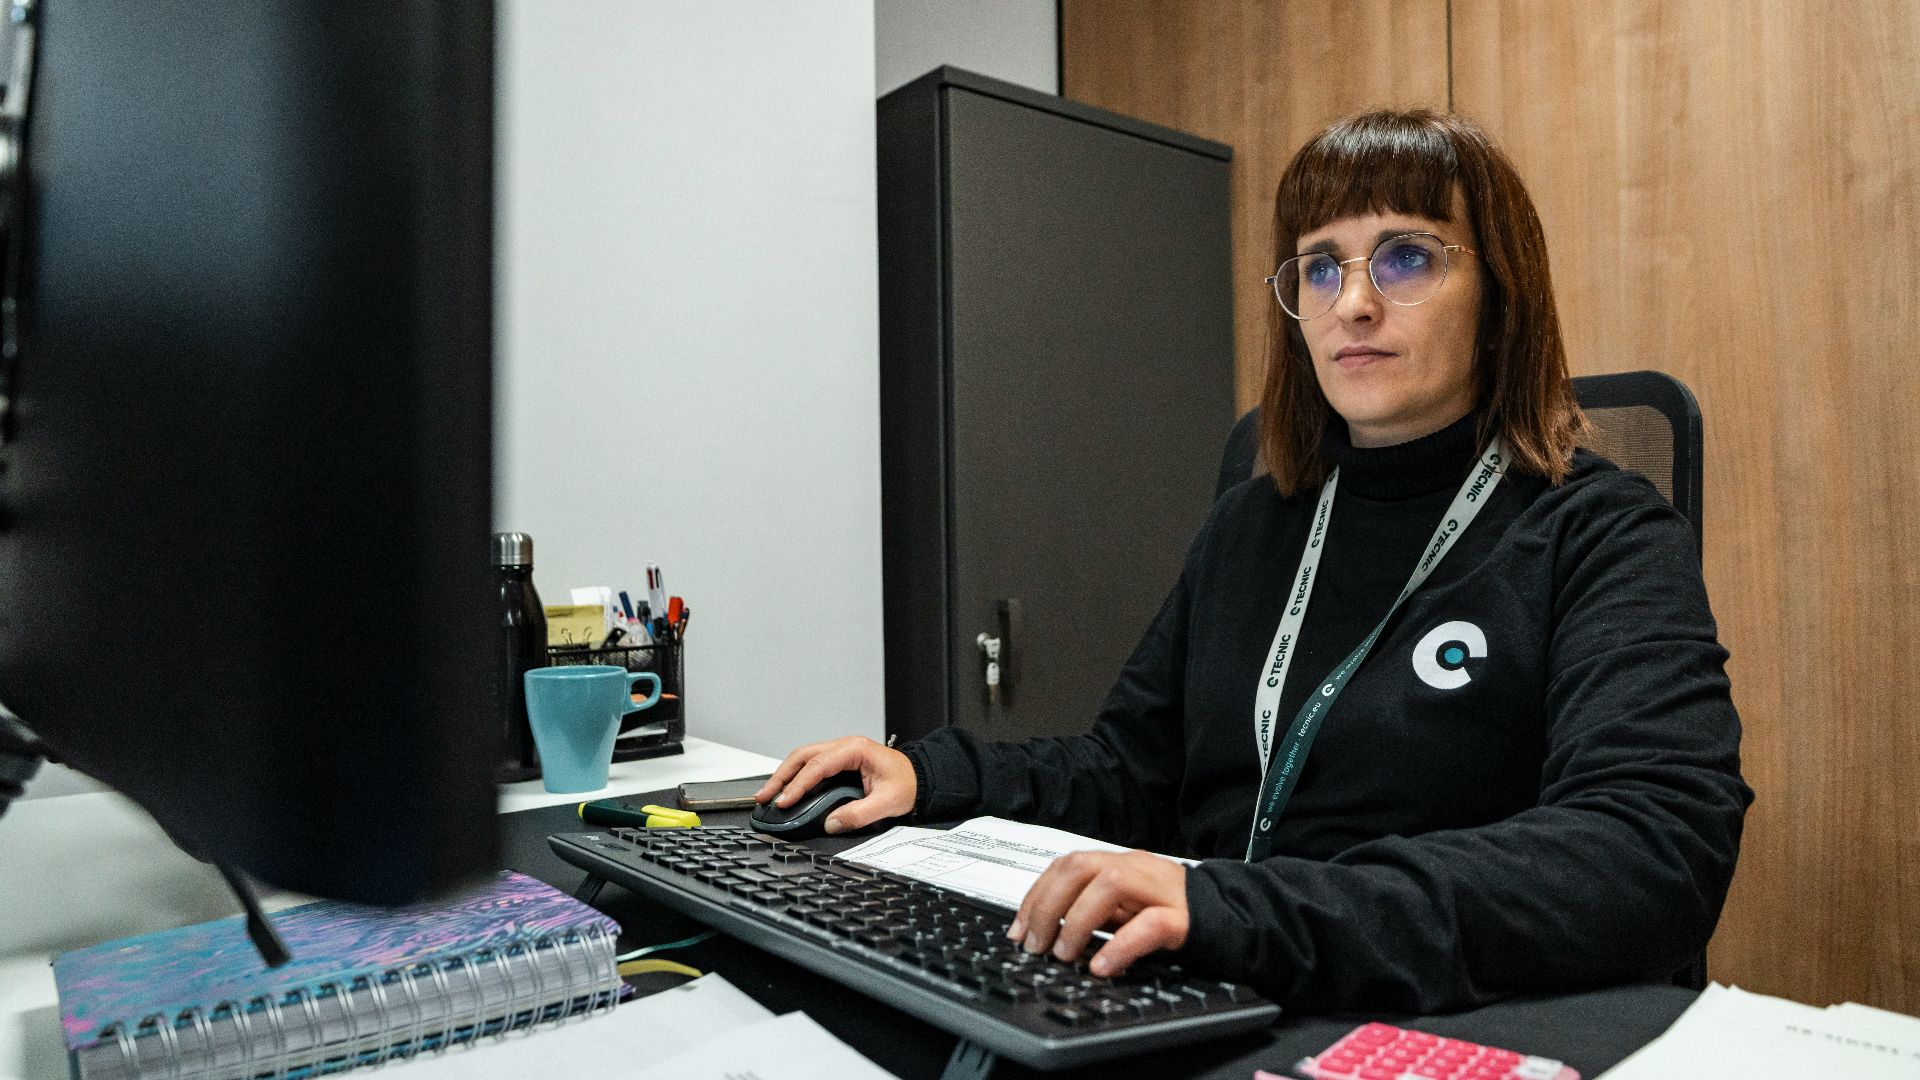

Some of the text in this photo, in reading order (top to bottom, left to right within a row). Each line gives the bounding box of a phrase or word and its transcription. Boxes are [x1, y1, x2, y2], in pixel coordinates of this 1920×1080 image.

[1314, 500, 1329, 539] TECNIC
[1421, 530, 1451, 572] TECNIC
[1294, 566, 1312, 606] TECNIC
[1270, 633, 1292, 676] TECNIC
[1335, 670, 1346, 680] we
[1266, 702, 1322, 813] we evolve together tecnic.eu
